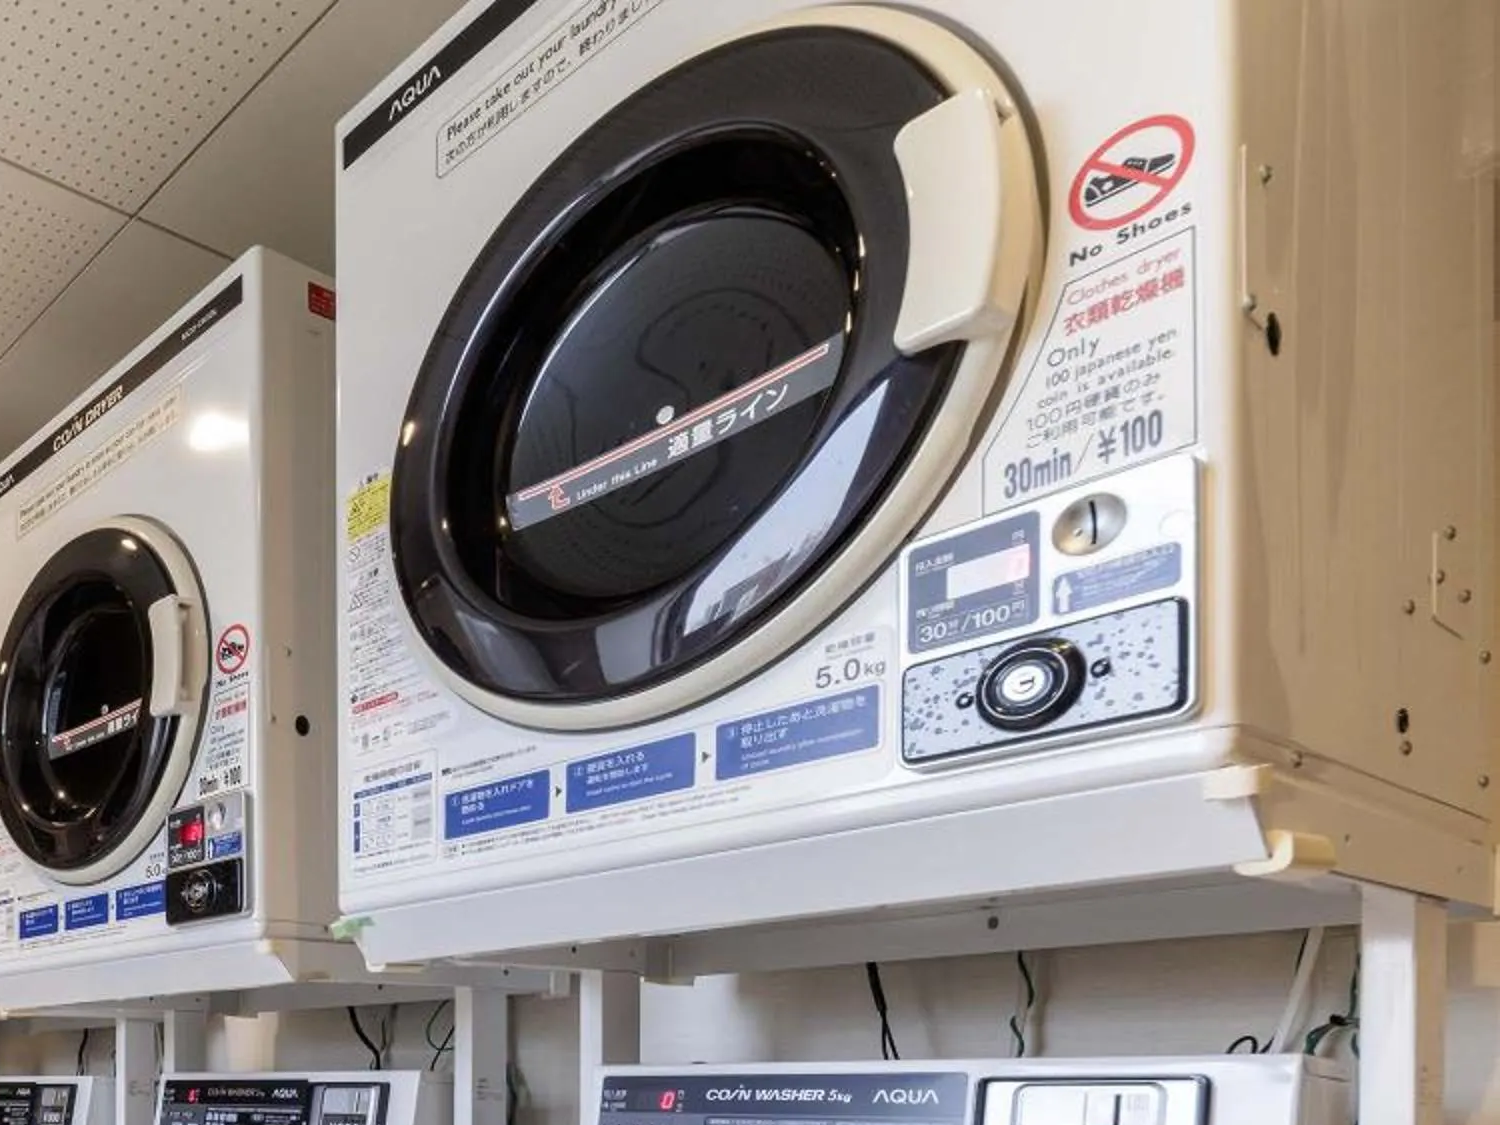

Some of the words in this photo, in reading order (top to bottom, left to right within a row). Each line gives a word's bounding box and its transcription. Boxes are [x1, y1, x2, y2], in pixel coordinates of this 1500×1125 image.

[388, 65, 441, 121] AQUA
[446, 106, 482, 141] Please
[485, 83, 512, 109] take
[513, 65, 535, 86] out
[536, 35, 567, 69] your
[1069, 244, 1103, 267] No
[1116, 202, 1193, 246] Shoes
[1063, 266, 1185, 337] 衣類乾燥機
[1066, 273, 1130, 306] Clothes
[1136, 248, 1182, 276] dryer
[1045, 369, 1070, 390] 100
[1074, 342, 1142, 380] japanese
[1046, 336, 1100, 367] Only
[666, 382, 790, 460] 適量ライン
[1037, 390, 1068, 410] coin
[1003, 447, 1073, 500] 30min
[1096, 409, 1164, 466] ¥100
[576, 479, 609, 502] Under
[660, 1091, 676, 1110] 0
[755, 1088, 825, 1102] WASHER
[872, 1088, 940, 1105] AQUA
